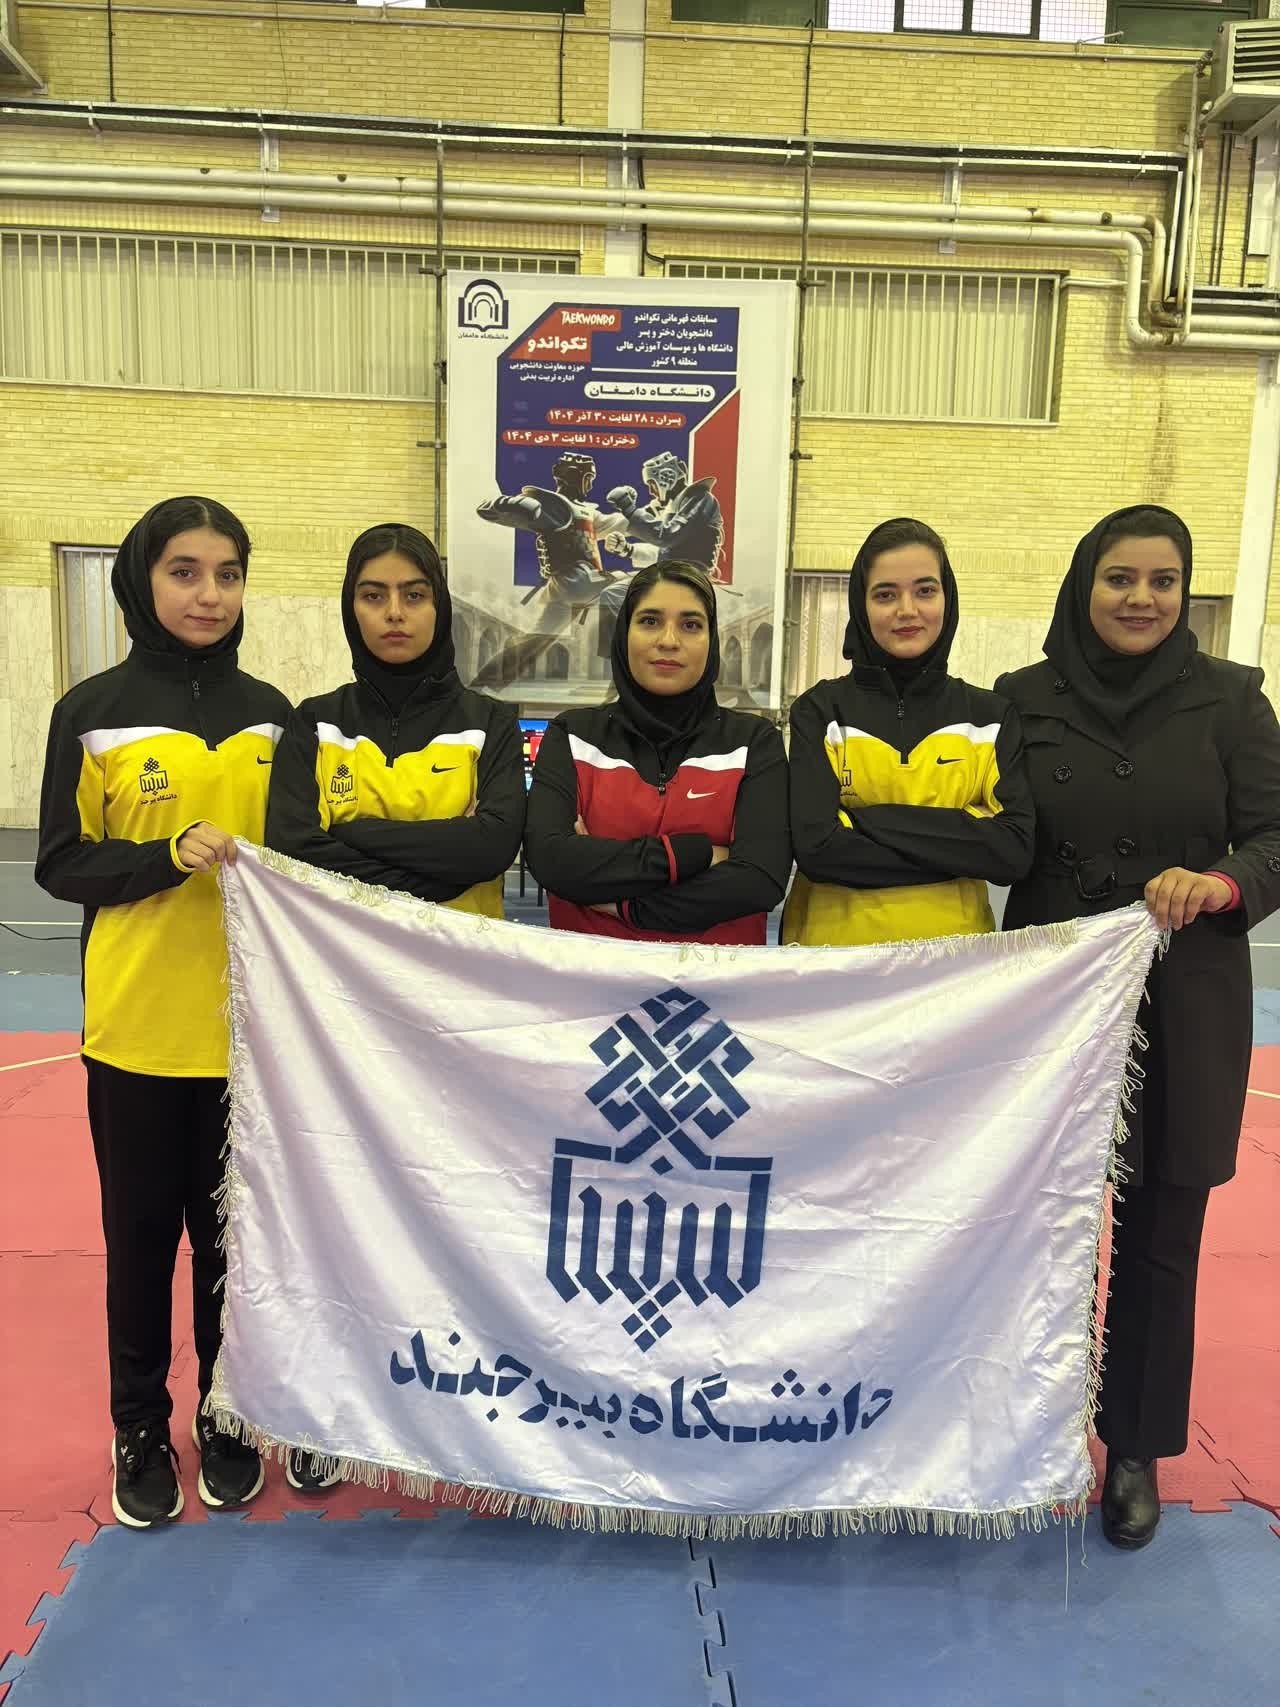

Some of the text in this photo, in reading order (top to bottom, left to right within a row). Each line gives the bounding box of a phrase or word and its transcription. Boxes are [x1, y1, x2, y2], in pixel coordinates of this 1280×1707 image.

[561, 311, 615, 326] TAEKWONDO
[634, 312, 718, 325] مسابقات قهرمانی تکواندو
[638, 329, 651, 338] پسر
[658, 328, 675, 338] دختر
[676, 328, 713, 339] دانشجویان
[528, 336, 587, 354] تکواندو
[616, 341, 634, 351] عالی
[635, 341, 661, 352] آموزش
[707, 343, 734, 352] دانشگاه
[509, 362, 542, 370] دانشجویی
[544, 362, 567, 371] معاونت
[651, 356, 670, 367] کشور
[678, 357, 698, 366] منطقه
[520, 371, 575, 382] اداره تربیت بدنی
[590, 385, 711, 397] دانشگاه دامغان
[549, 410, 574, 420] ۱۴۰۴
[576, 411, 592, 423] آذر
[594, 412, 606, 421] ۳۰
[608, 413, 633, 423] لغایت
[634, 413, 648, 422] ۲۸
[655, 415, 682, 426] پسران
[507, 431, 532, 441] ۱۴۰۴
[534, 434, 550, 443] دی
[551, 433, 560, 442] ۳
[561, 434, 586, 444] لغایت
[601, 436, 636, 446] دختران
[390, 1329, 893, 1443] دانشگاه بیرجند
